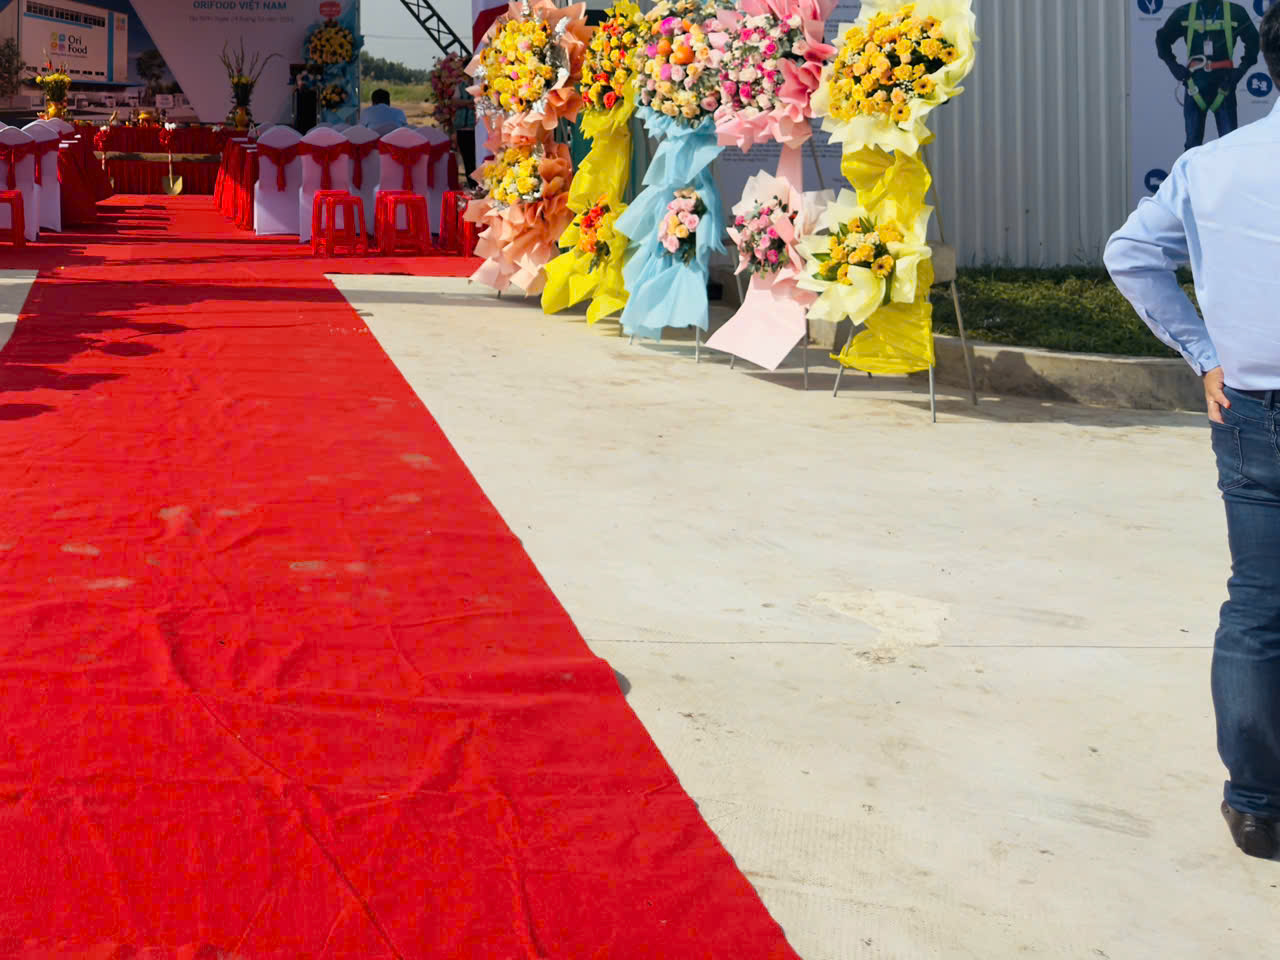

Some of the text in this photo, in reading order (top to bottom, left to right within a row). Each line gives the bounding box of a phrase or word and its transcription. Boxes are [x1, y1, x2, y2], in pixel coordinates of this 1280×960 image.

[193, 1, 236, 9] ORIFOOD
[264, 1, 287, 9] NAM
[68, 35, 82, 45] Ori
[68, 44, 88, 54] Food
